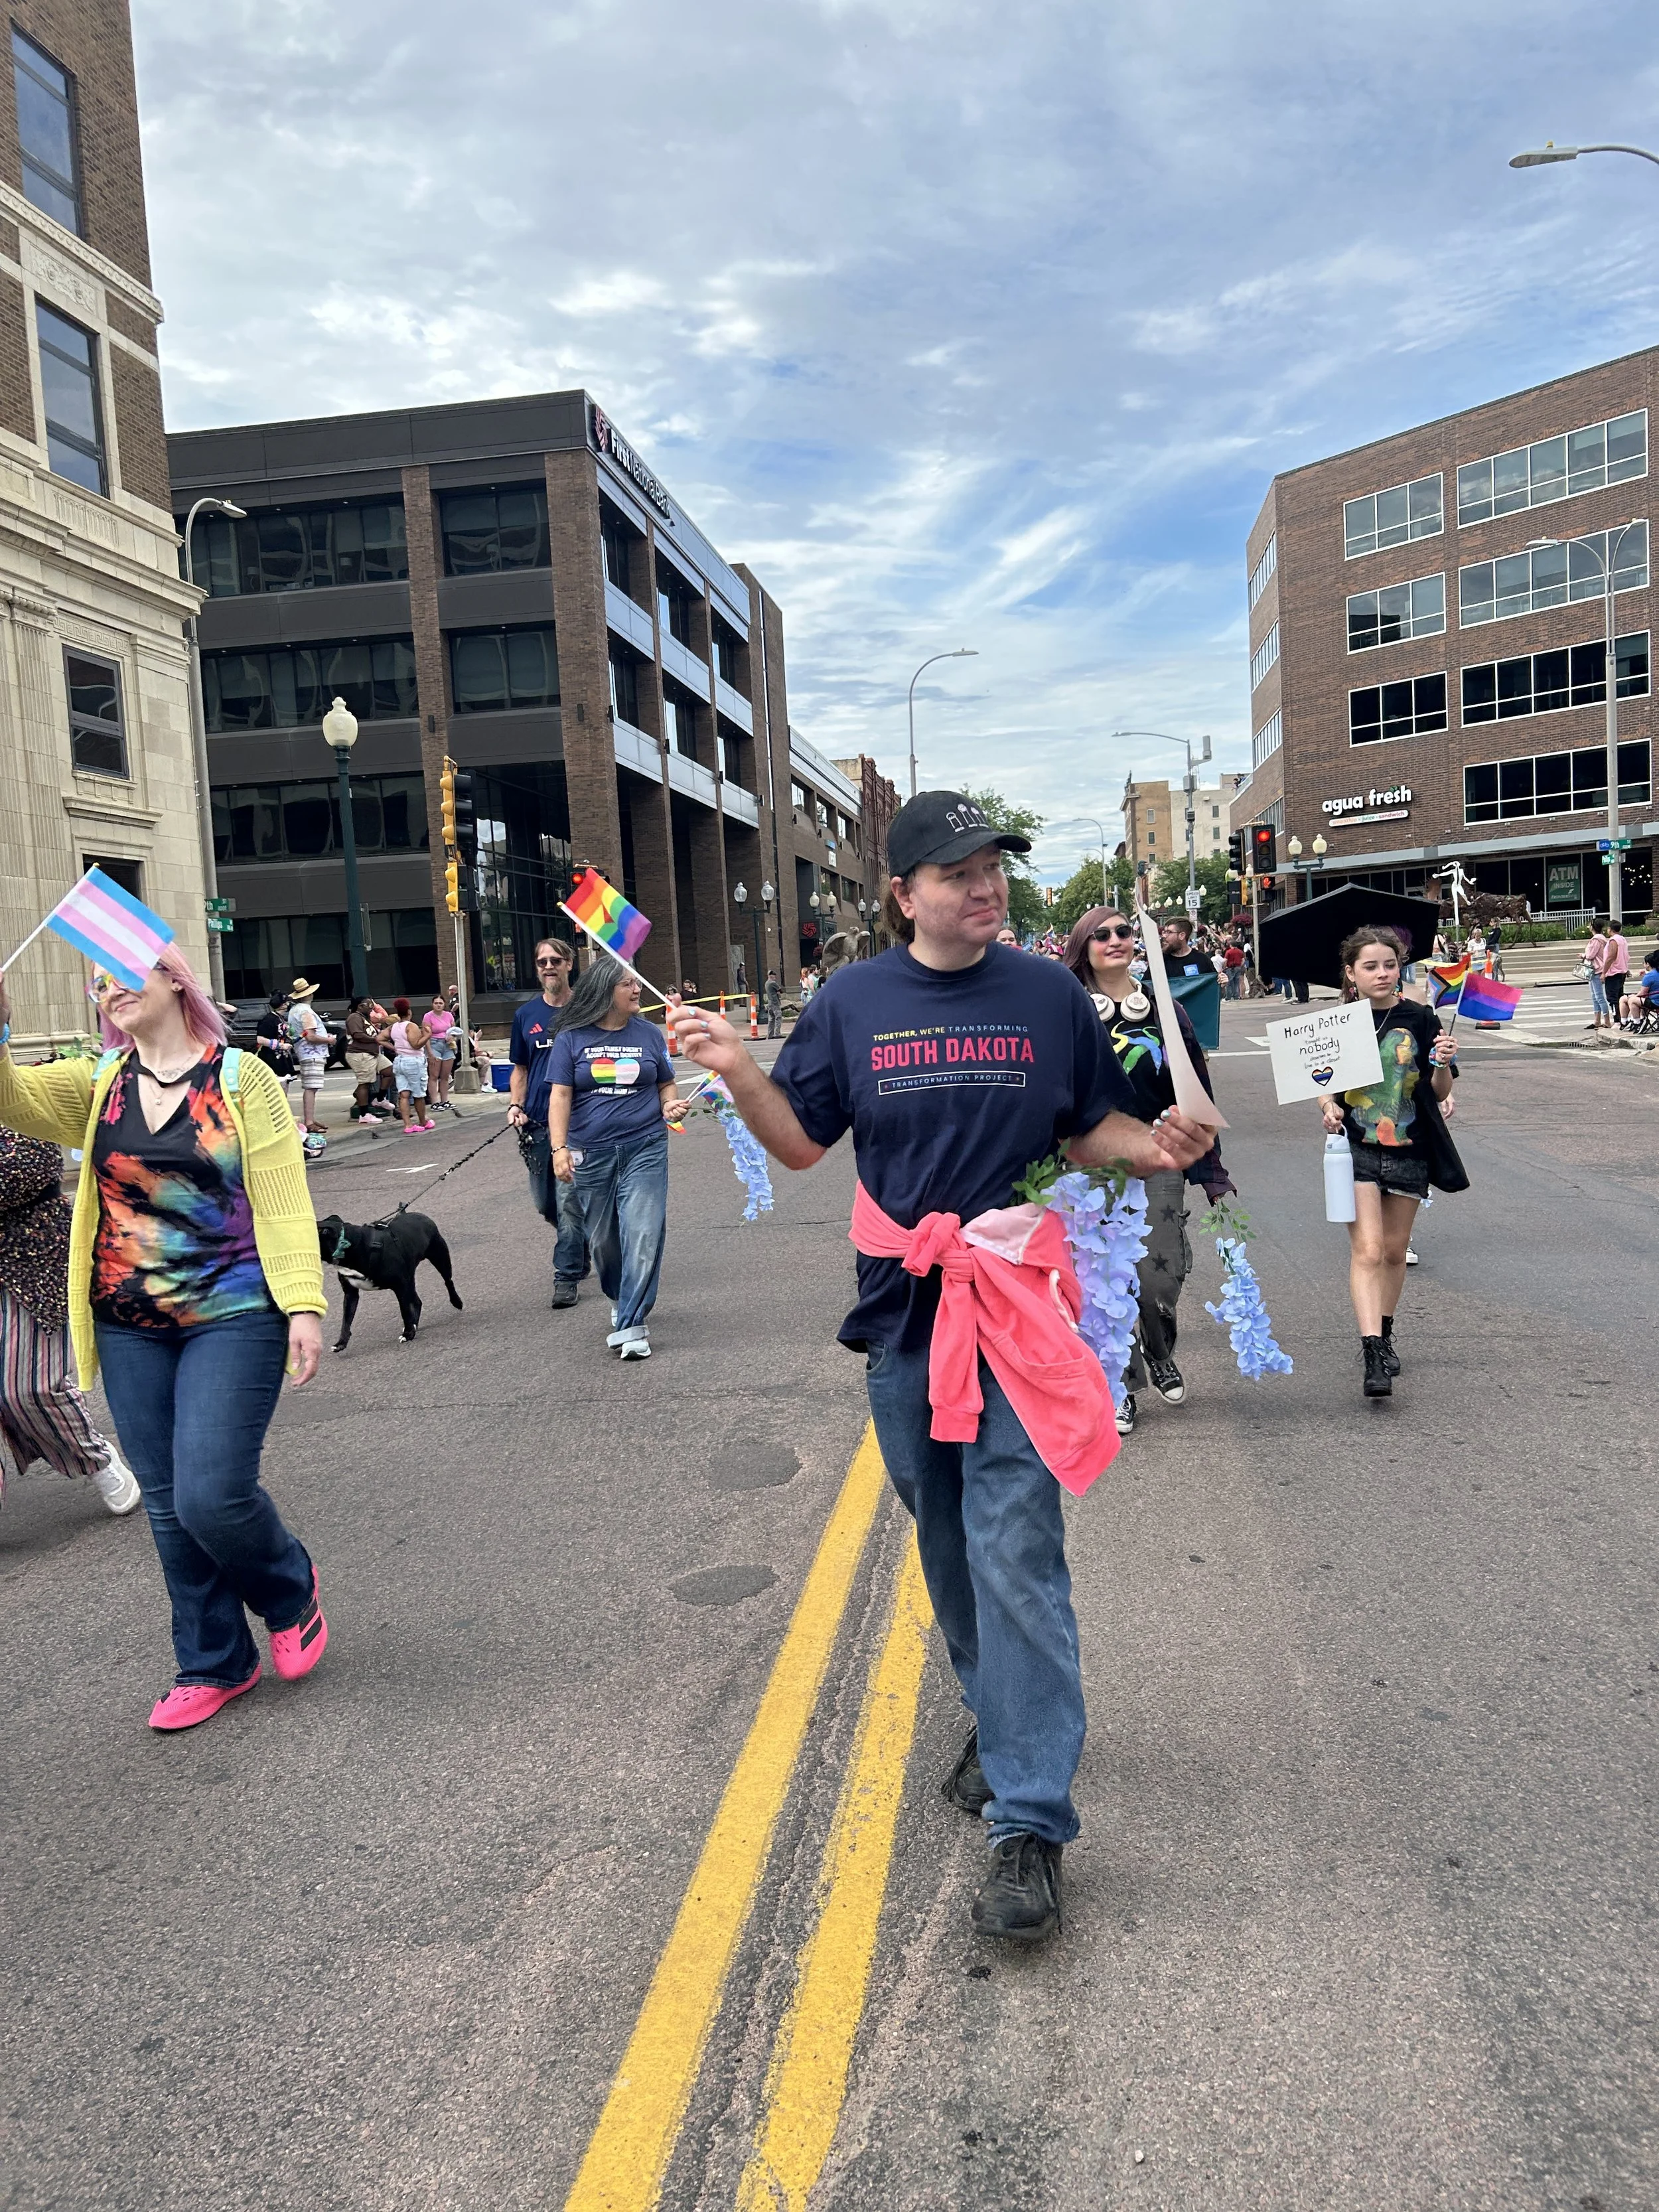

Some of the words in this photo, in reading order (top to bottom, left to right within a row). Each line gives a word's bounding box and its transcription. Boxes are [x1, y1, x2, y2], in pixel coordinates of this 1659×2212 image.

[611, 428, 630, 472] First
[630, 451, 656, 502] National
[655, 482, 670, 518] Bank
[1321, 796, 1364, 816] agua
[1368, 785, 1412, 806] fresh
[1379, 811, 1405, 820] sandwich
[1550, 865, 1579, 881] ATM
[873, 1029, 918, 1041] TOGETHER,
[920, 1026, 946, 1035] WE'RE
[1284, 1023, 1315, 1038] Harry
[1319, 1013, 1351, 1029] Potter
[871, 1039, 938, 1071] SOUTH
[945, 1036, 1035, 1063] DAKOTA
[1299, 1037, 1340, 1055] nobody
[892, 1074, 970, 1088] TRANSFORMATION
